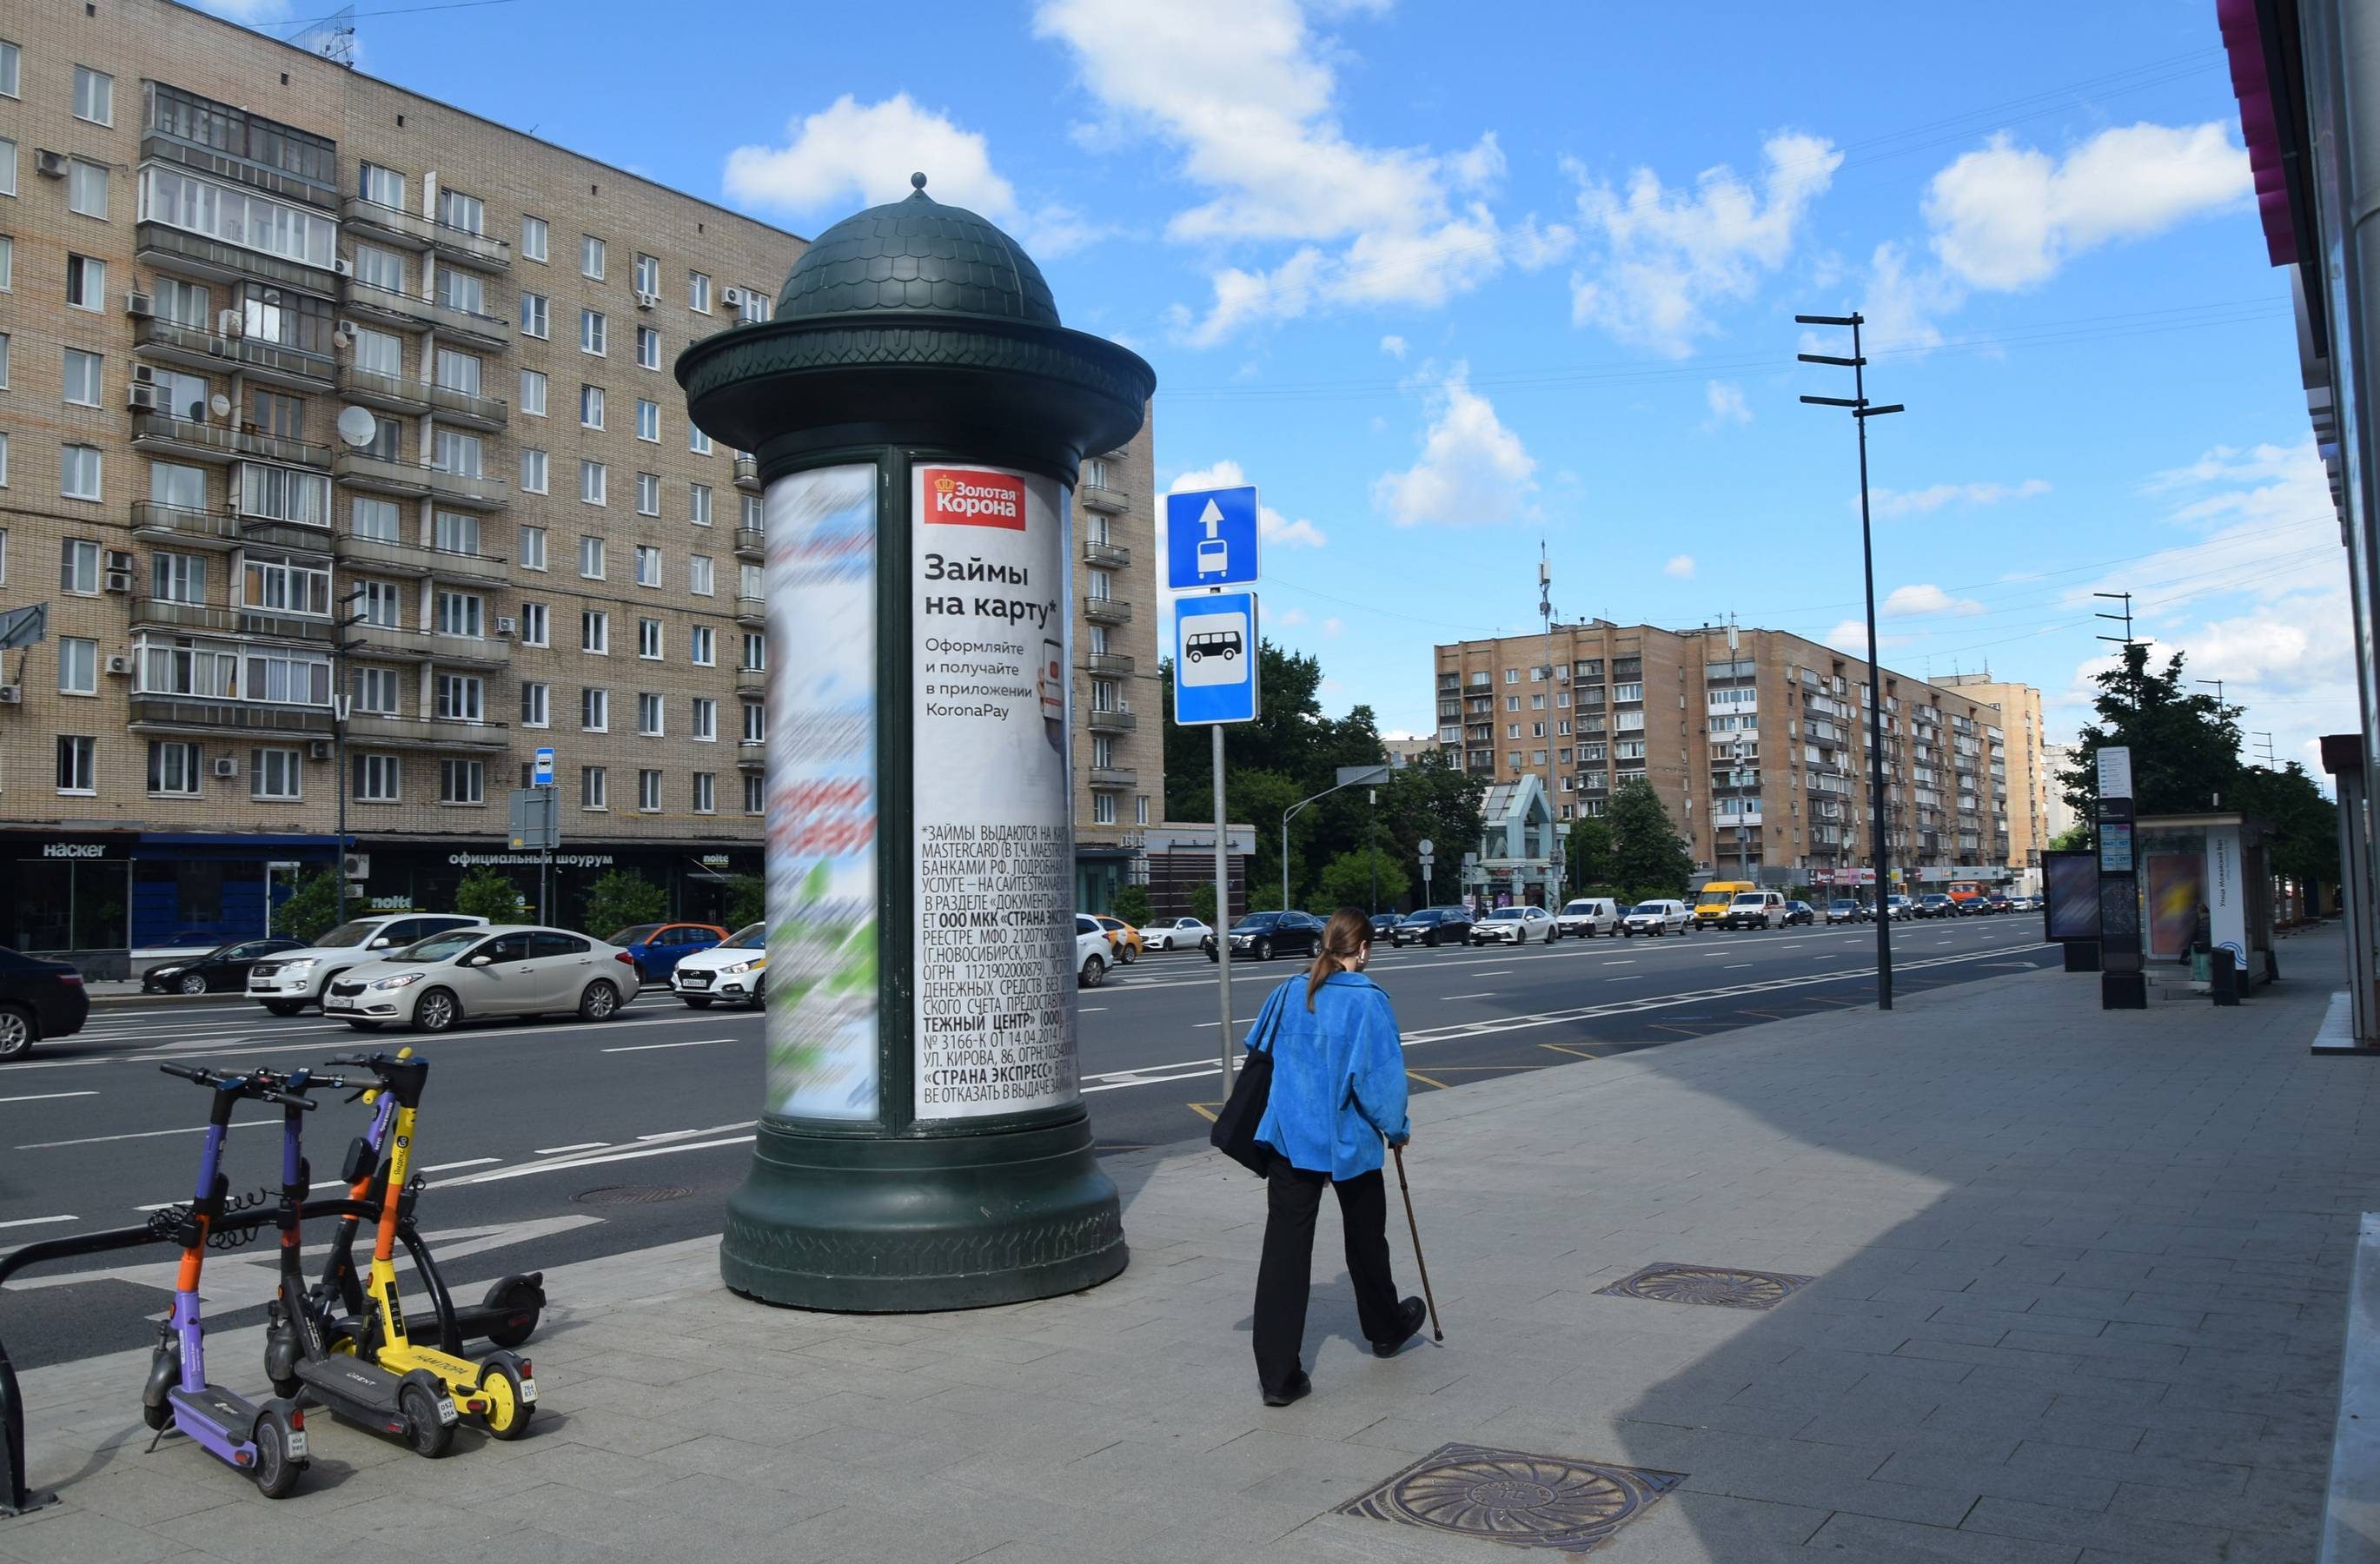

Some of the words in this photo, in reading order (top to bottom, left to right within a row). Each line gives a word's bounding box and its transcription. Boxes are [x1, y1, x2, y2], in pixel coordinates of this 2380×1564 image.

[955, 481, 1017, 500] Золотая
[937, 491, 1016, 517] Корона
[925, 553, 1028, 586] Займы
[925, 596, 965, 616] на
[925, 638, 1024, 656] Оформляйте
[926, 663, 935, 673] и
[941, 662, 1019, 676] получайте
[927, 685, 934, 694] в
[940, 682, 1031, 699] приложении
[927, 704, 1009, 721] KoronaPay
[981, 825, 1037, 843] ВЫДАЮТСЯ
[1041, 827, 1051, 839] НА
[448, 851, 553, 868] официальный
[555, 854, 613, 868] шоурум
[702, 853, 729, 864] nolte
[922, 843, 998, 858] MASTERCARD
[923, 860, 985, 875] БАНКАМИ
[991, 860, 1010, 875] РФ.
[922, 878, 965, 892] УСЛУГЕ
[978, 878, 995, 891] НА
[996, 874, 1026, 891] САЙТЕ
[925, 896, 932, 911] В
[936, 895, 988, 912] РАЗДЕЛЕ
[923, 912, 936, 928] ЕТ
[939, 913, 966, 927] ООО
[971, 912, 998, 926] МКК
[1001, 911, 1044, 925] «СТРАНА
[924, 930, 973, 945] РЕЕСТРЕ
[980, 929, 1006, 944] МФО
[924, 965, 954, 980] ОГРН
[924, 981, 994, 1000] ДЕНЕЖНЫХ
[1000, 978, 1042, 996] СРЕДСТВ
[1046, 978, 1059, 991] БЕЗ
[924, 998, 961, 1015] СКОГО
[967, 997, 1001, 1014] СЧЕТА
[924, 1012, 985, 1032] ТЕЖНЫЙ
[993, 1012, 1036, 1033] ЦЕНТР»
[942, 1032, 986, 1050] 3166-К
[991, 1031, 1007, 1047] ОТ
[1010, 1028, 1057, 1045] 14.04.2014
[924, 1051, 943, 1067] УЛ.
[947, 1050, 998, 1067] КИРОВА,
[1001, 1049, 1016, 1065] 86,
[925, 1067, 987, 1085] «СТРАНА
[991, 1062, 1052, 1083] ЭКСПРЕСС»
[925, 1087, 938, 1103] ВЕ
[942, 1084, 1000, 1103] ОТКАЗАТЬ
[1003, 1084, 1009, 1099] В
[1012, 1080, 1050, 1098] ВЫДАЧЕ
[394, 1149, 405, 1176] Яндекс
[441, 1401, 454, 1411] 052
